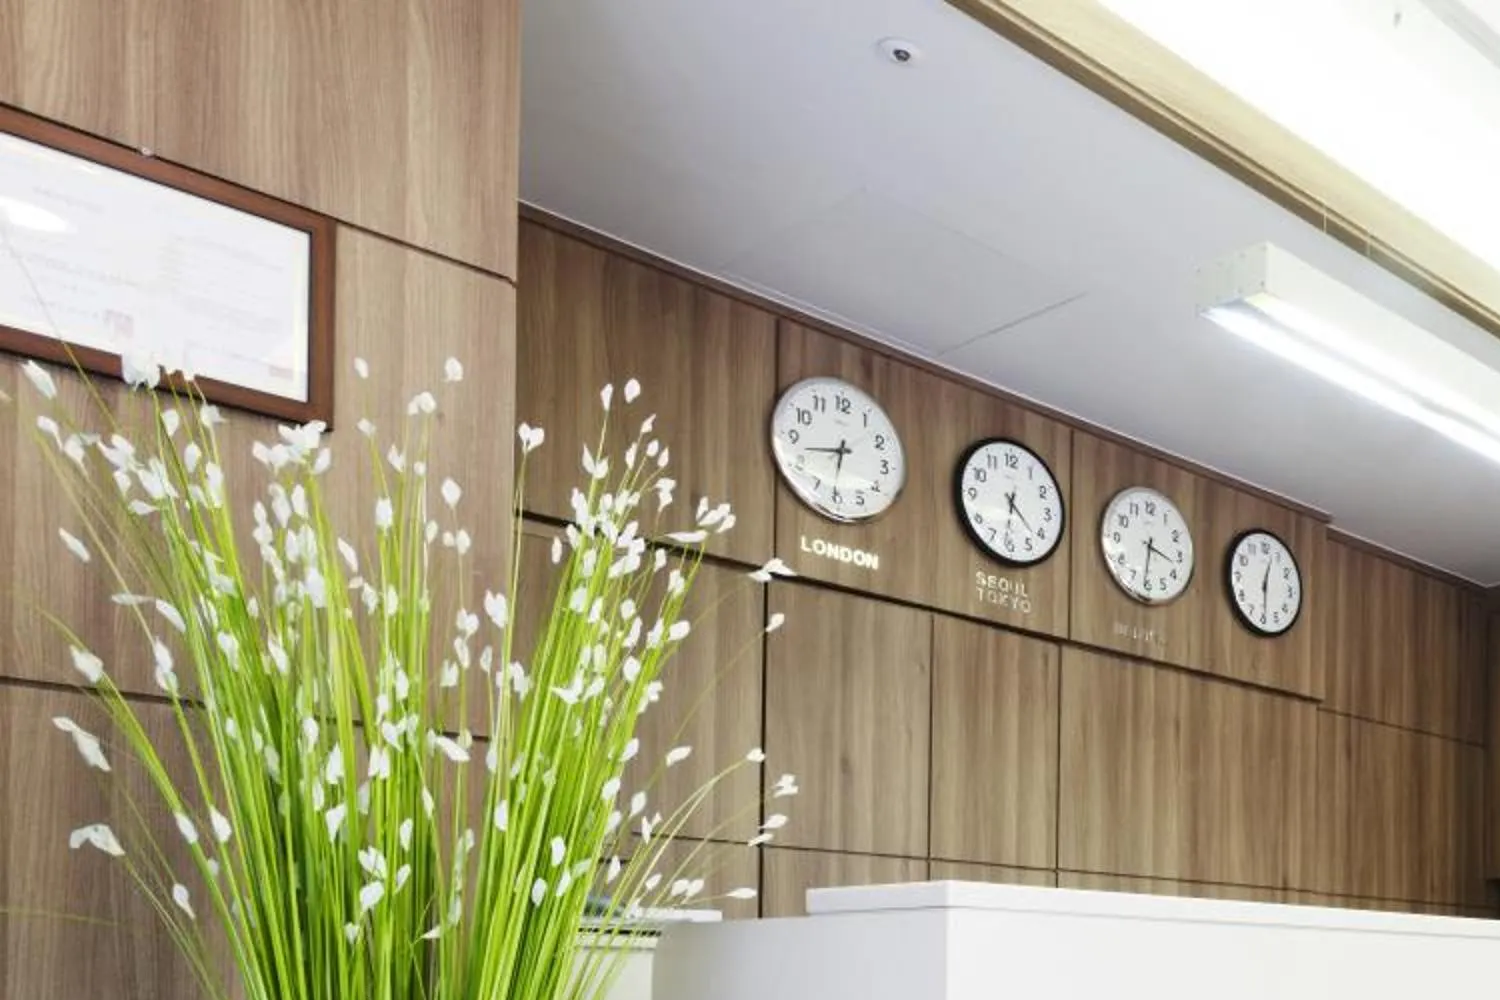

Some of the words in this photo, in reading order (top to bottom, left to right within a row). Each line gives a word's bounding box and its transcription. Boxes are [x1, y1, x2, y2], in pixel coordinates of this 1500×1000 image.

[813, 395, 826, 412] 11
[835, 395, 851, 415] 12
[796, 407, 812, 425] 10
[788, 429, 799, 445] 9
[875, 435, 886, 451] 2
[879, 459, 889, 475] 3
[986, 454, 998, 470] 11
[1004, 452, 1019, 469] 12
[973, 467, 987, 483] 10
[812, 476, 821, 491] 7
[832, 487, 843, 504] 6
[856, 490, 865, 506] 5
[968, 487, 977, 501] 9
[1039, 485, 1047, 500] 2
[1044, 507, 1052, 521] 3
[987, 528, 997, 542] 7
[1037, 527, 1045, 540] 4
[1005, 539, 1014, 553] 6
[1025, 538, 1033, 551] 5
[801, 536, 879, 570] LONDON
[975, 571, 1028, 598] SEOUL
[976, 587, 1031, 613] TOKYO
